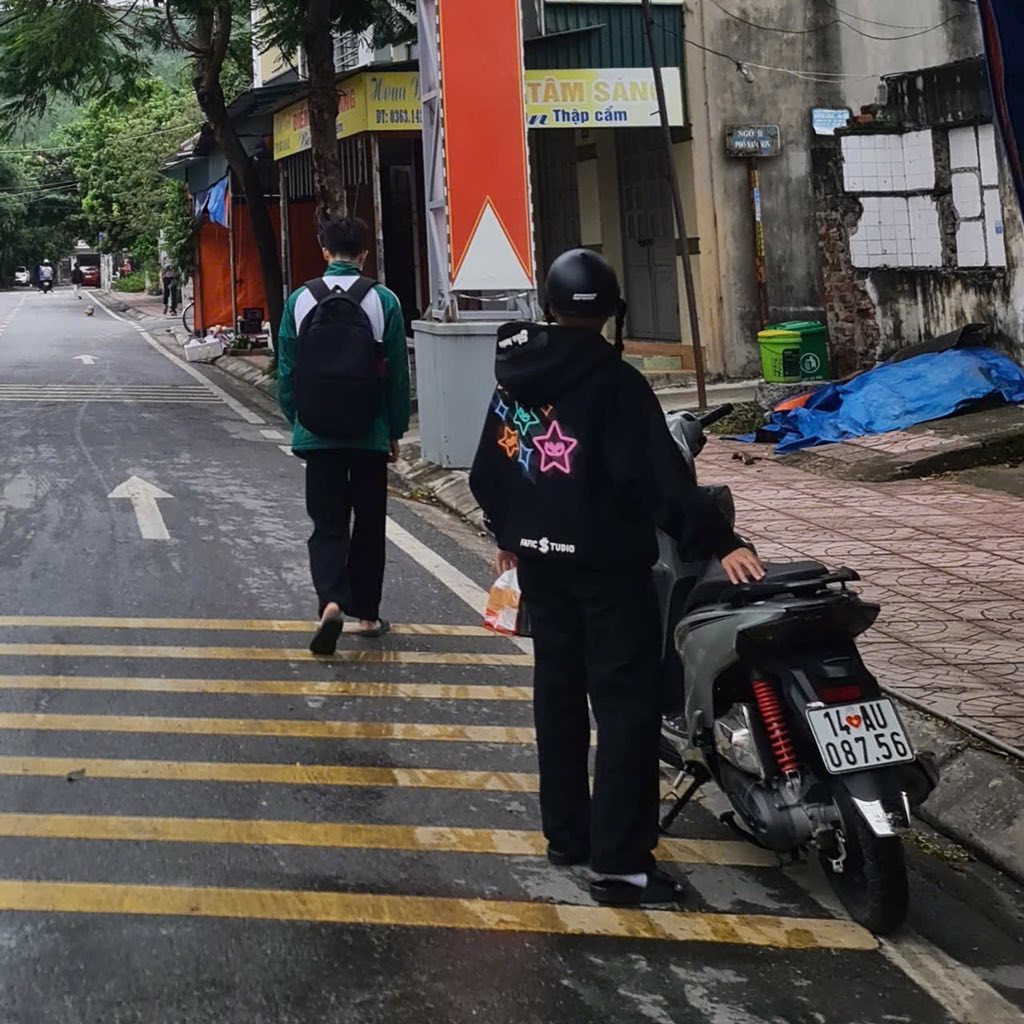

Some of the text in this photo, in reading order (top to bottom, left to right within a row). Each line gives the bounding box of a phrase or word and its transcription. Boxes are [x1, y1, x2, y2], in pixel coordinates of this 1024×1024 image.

[527, 78, 585, 102] TÂM
[553, 109, 589, 125] Thập
[826, 731, 908, 768] 087.56
